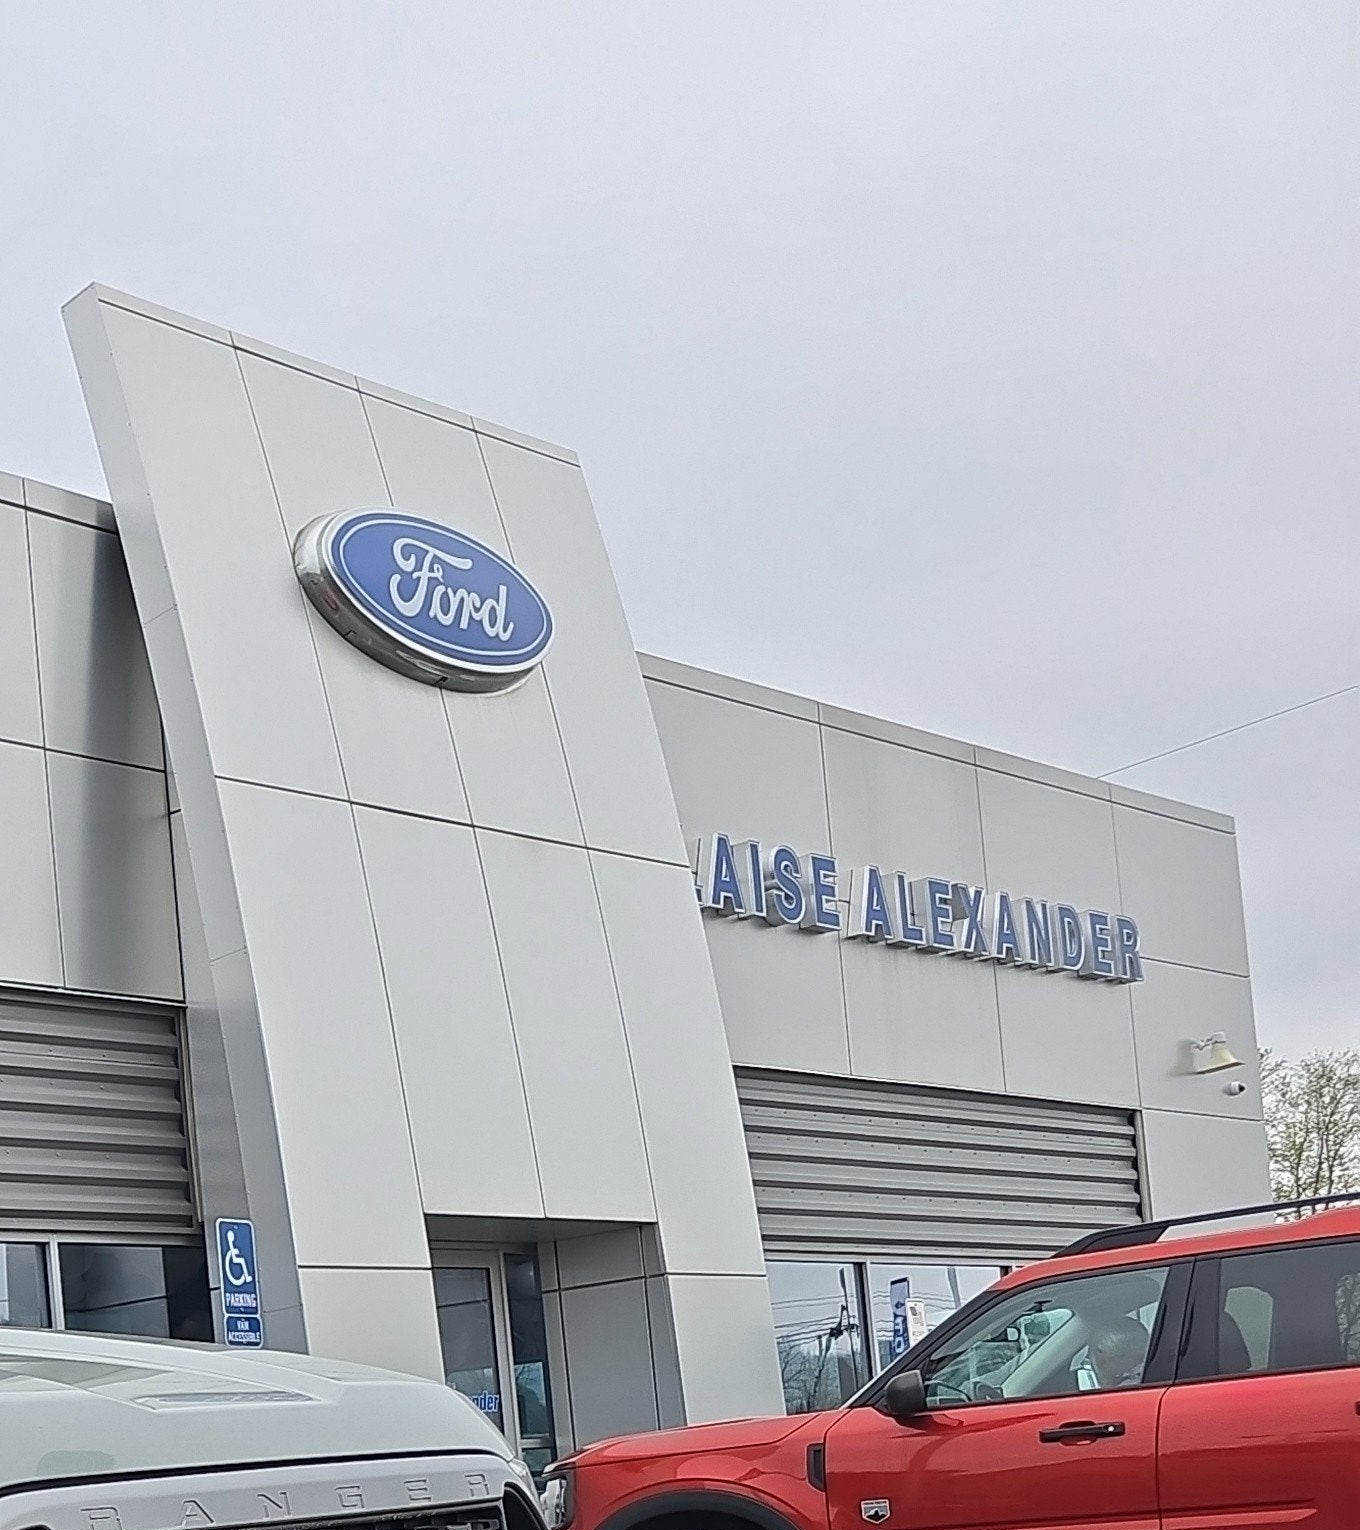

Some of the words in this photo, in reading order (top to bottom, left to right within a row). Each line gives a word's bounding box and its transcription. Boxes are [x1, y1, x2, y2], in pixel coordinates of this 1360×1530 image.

[389, 536, 516, 642] Ford
[700, 832, 842, 931] AISE
[858, 864, 1145, 982] ALEXANDER
[225, 1293, 257, 1308] PARKING
[236, 1320, 250, 1331] VAN
